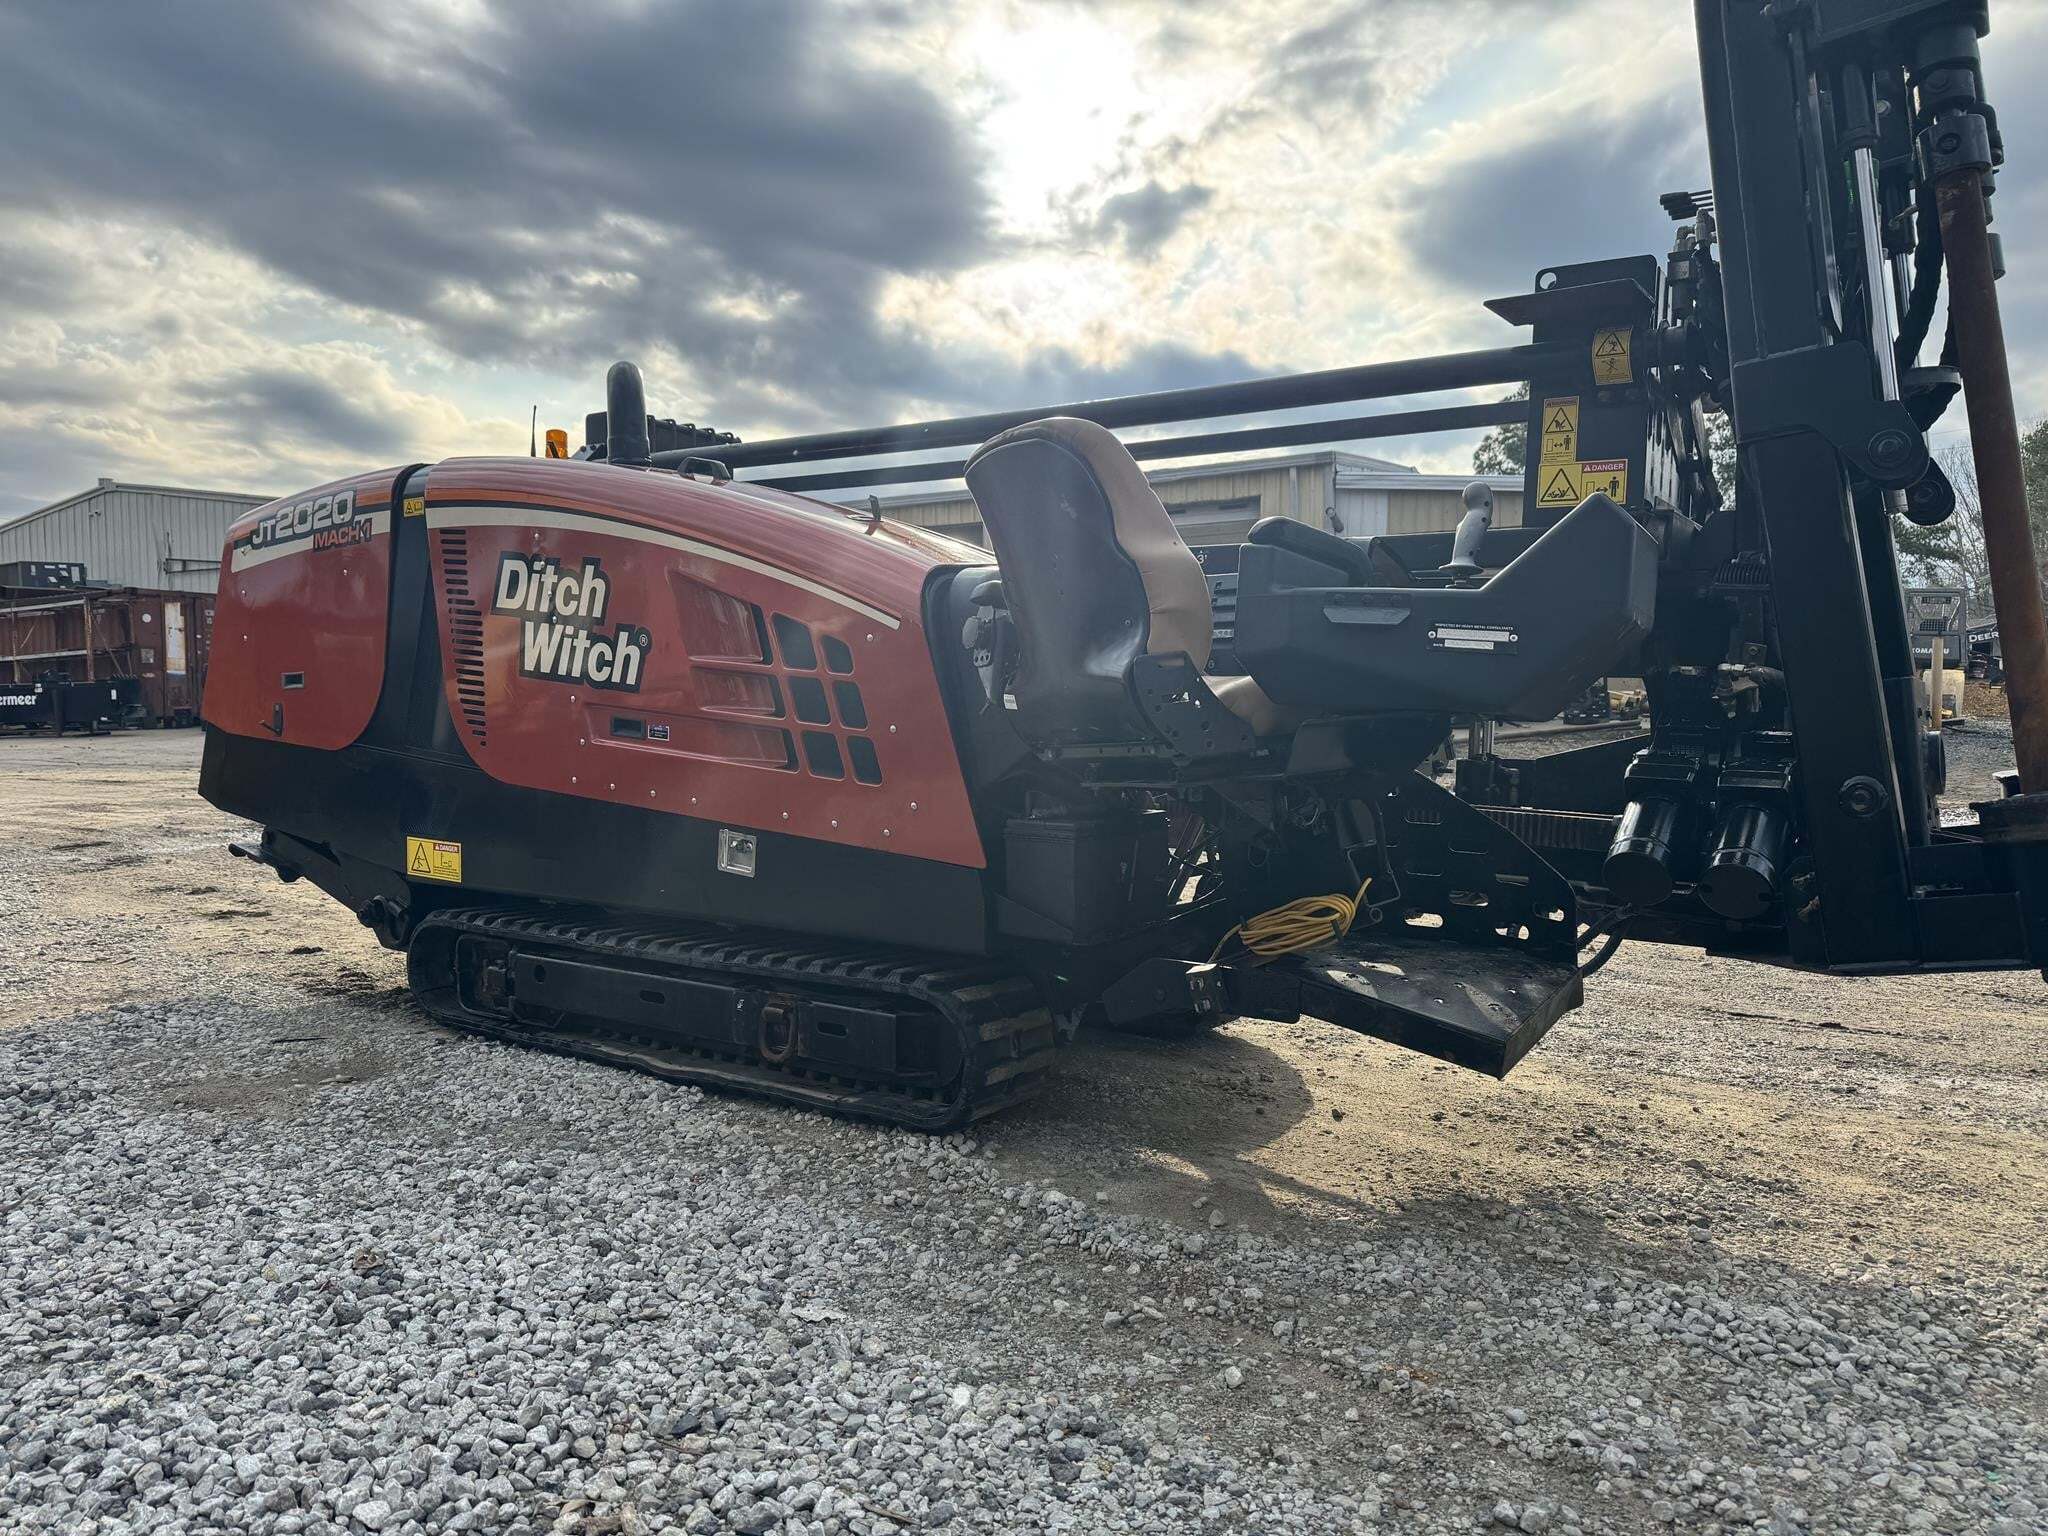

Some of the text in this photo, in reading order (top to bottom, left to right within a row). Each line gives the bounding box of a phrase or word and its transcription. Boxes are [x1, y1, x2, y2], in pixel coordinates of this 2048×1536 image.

[1591, 463, 1624, 472] DANGER
[252, 490, 355, 545] JT2020
[314, 520, 360, 549] MACH
[496, 559, 606, 618] Ditch
[1968, 631, 2000, 643] DEER
[1911, 647, 1950, 655] OMAU
[0, 694, 37, 706] ermeer
